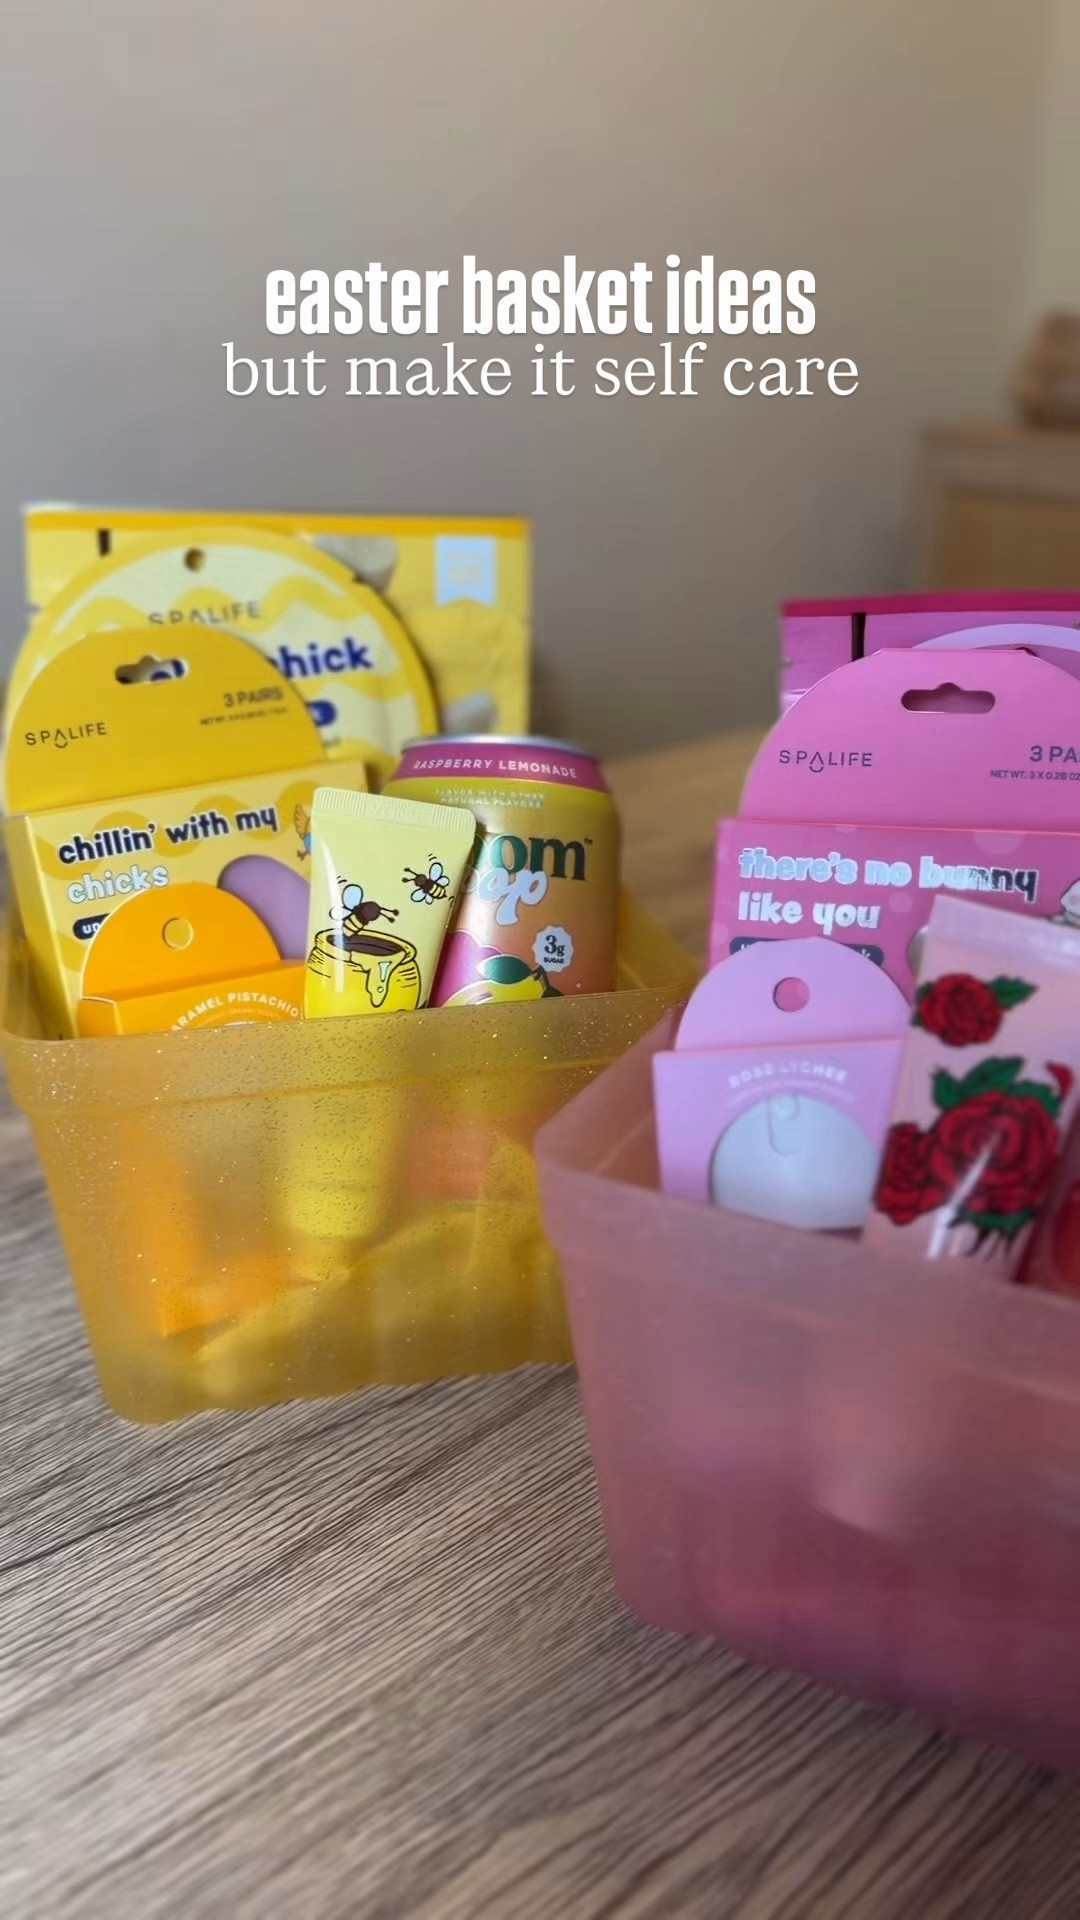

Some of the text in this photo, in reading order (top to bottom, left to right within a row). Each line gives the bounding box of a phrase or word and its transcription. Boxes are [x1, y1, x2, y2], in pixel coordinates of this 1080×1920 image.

[268, 637, 373, 680] hick
[223, 693, 234, 708] 3
[25, 722, 108, 749] SPALIFE
[778, 750, 873, 773] SPALIFE
[1029, 745, 1080, 763] 3 PA
[413, 758, 578, 779] RASPBERRY LEMONADE
[990, 769, 1009, 779] NET
[165, 809, 230, 845] with
[235, 805, 280, 836] my
[67, 863, 170, 906] chicks
[864, 859, 912, 888] no
[918, 856, 1039, 904] bunny
[738, 891, 881, 936] like you
[544, 934, 565, 957] 3g
[543, 956, 565, 964] SUGAR
[227, 991, 300, 1018] PISTACHIO
